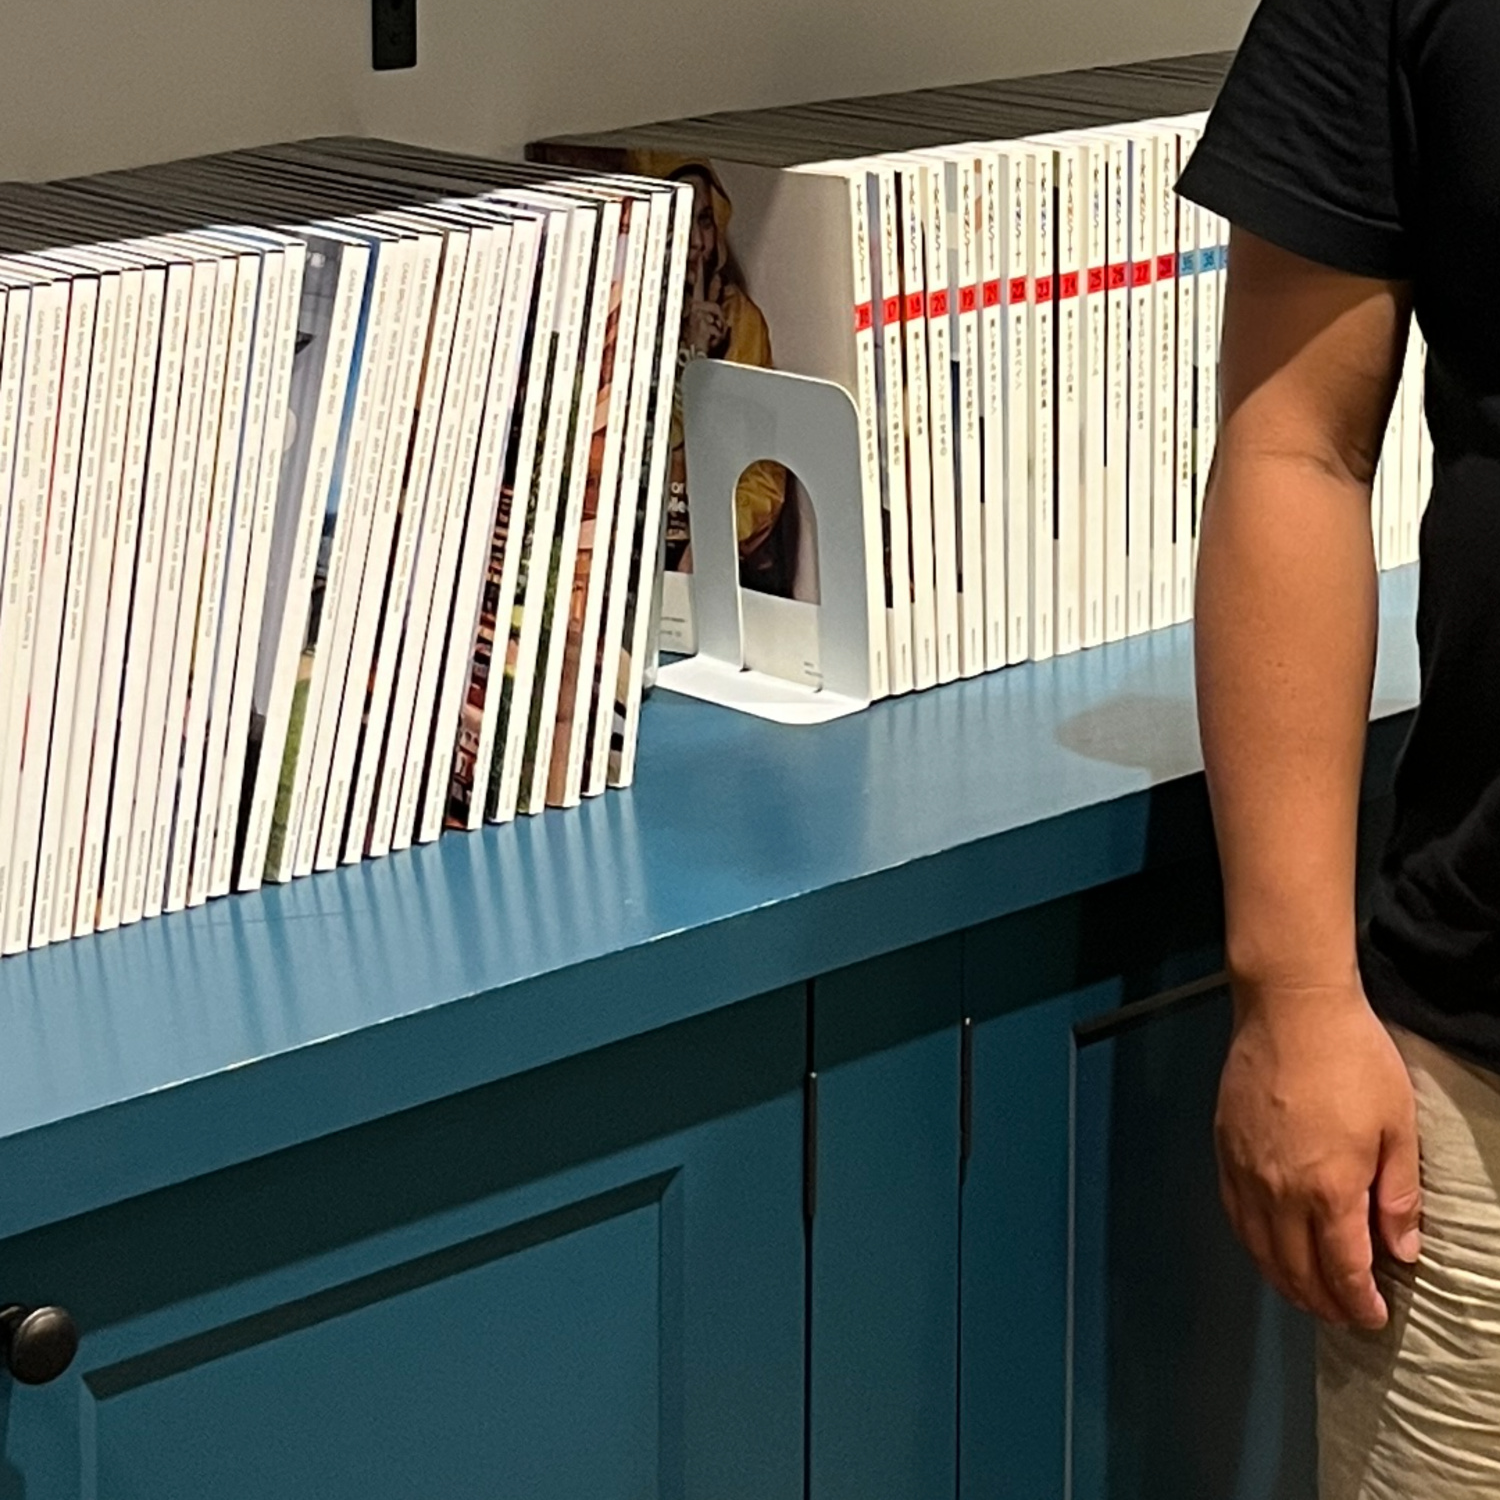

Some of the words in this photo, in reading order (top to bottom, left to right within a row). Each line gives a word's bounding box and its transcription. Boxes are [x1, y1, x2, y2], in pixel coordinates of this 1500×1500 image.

[856, 184, 866, 293] TRANSIT
[884, 179, 893, 286] TRANSIT
[909, 174, 918, 282] TRANSIT
[933, 173, 942, 281] TRANSIT
[963, 169, 972, 277] TRANSIT
[987, 164, 996, 271] TRANSIT
[1014, 161, 1022, 268] TRANSIT
